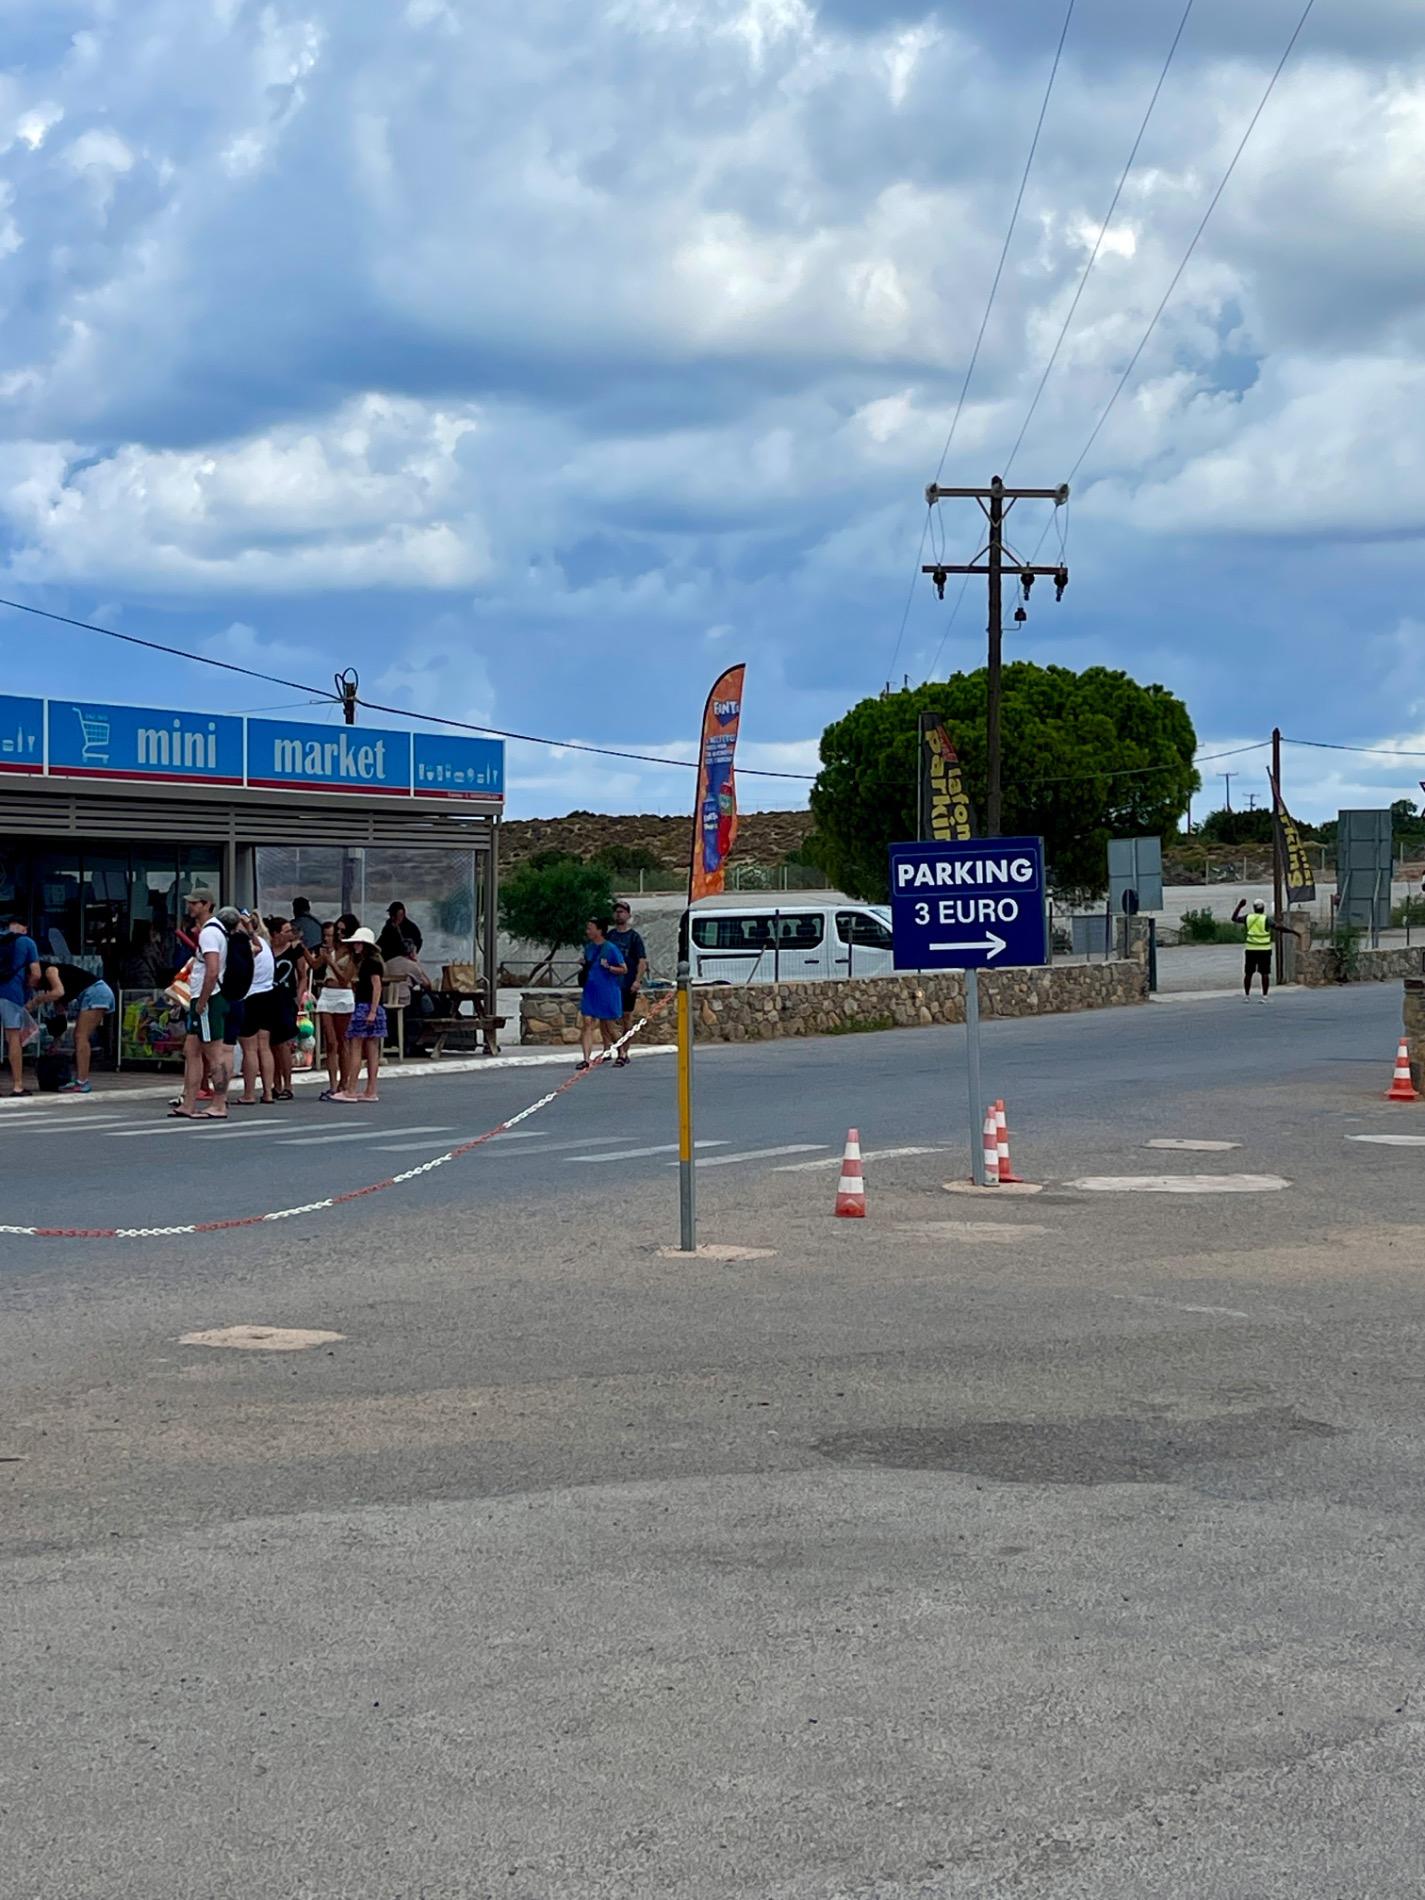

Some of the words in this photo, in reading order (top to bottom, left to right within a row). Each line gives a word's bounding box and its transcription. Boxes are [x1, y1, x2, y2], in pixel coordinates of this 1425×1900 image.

[137, 718, 217, 769] mini
[273, 733, 387, 780] market
[925, 729, 955, 841] parkin
[897, 858, 1033, 888] PARKING
[914, 902, 931, 926] 3
[938, 898, 1019, 925] EURO
